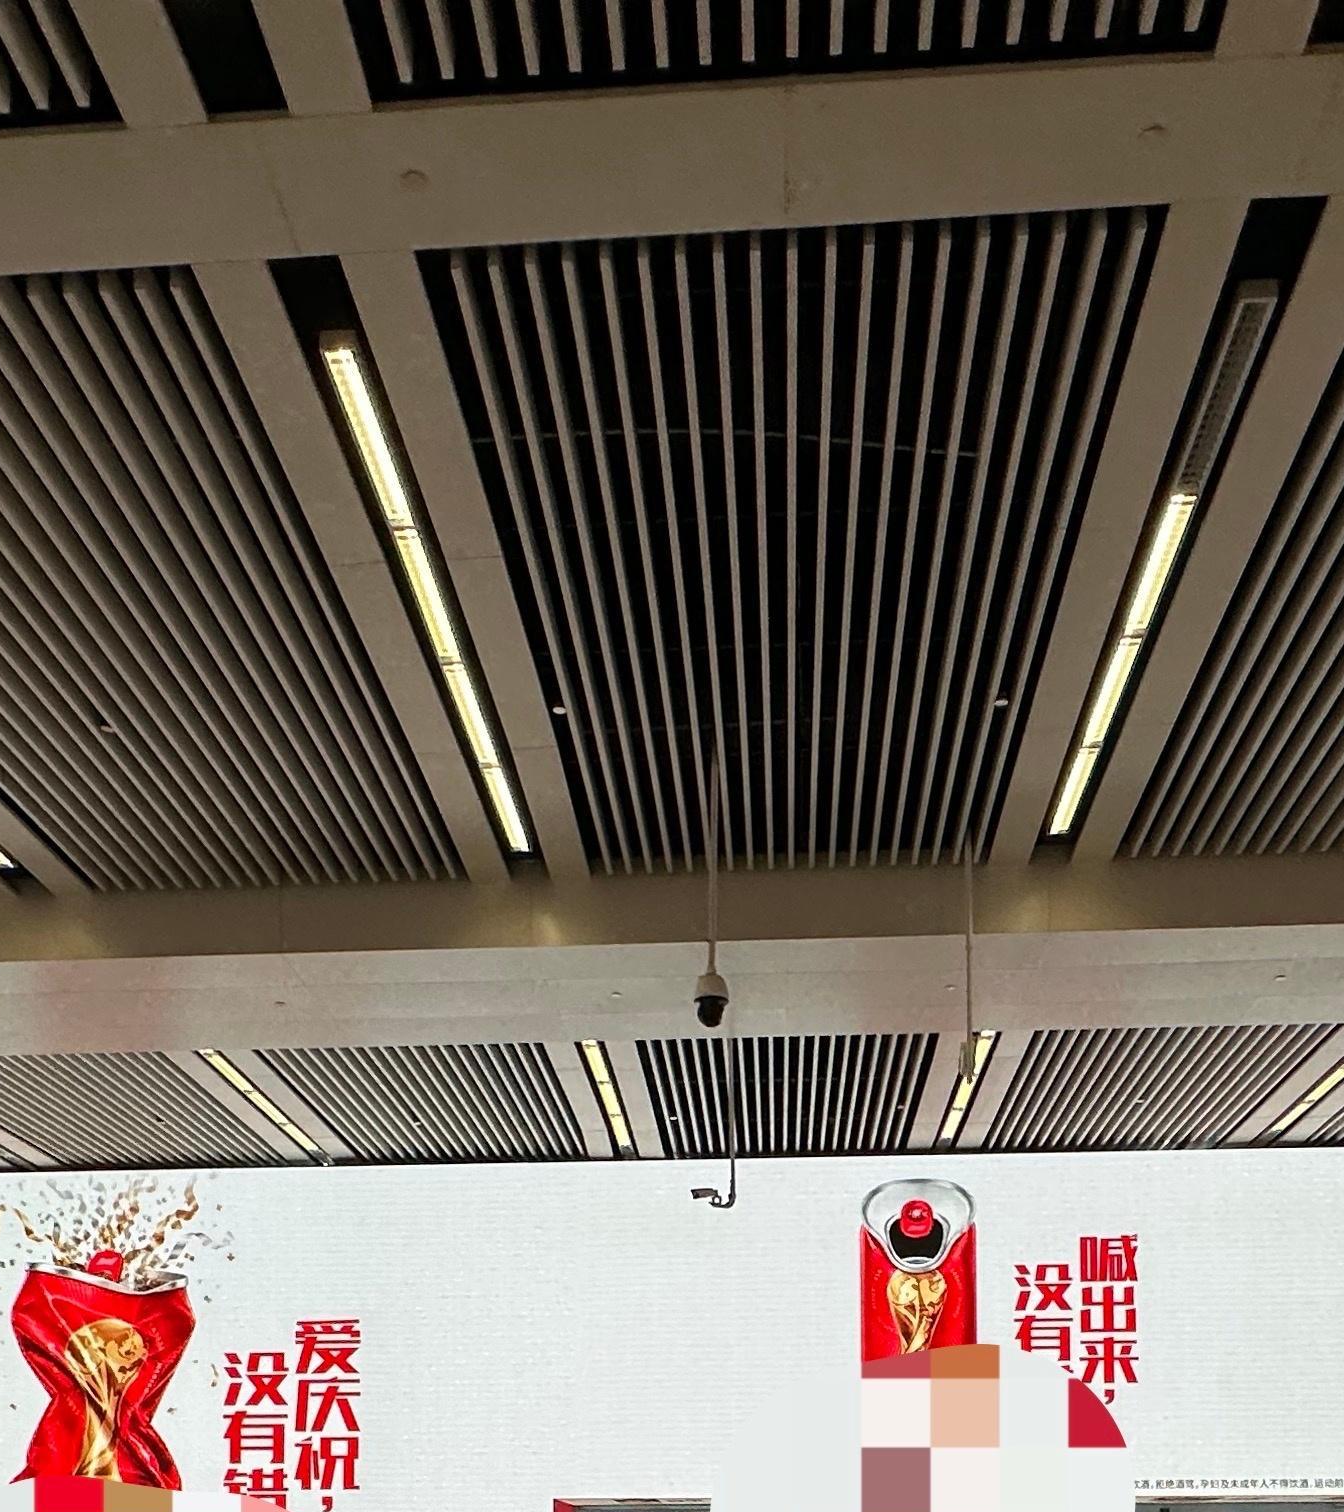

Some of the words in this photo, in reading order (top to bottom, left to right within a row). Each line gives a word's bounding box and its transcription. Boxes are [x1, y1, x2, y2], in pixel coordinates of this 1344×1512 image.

[1014, 1264, 1074, 1374] 没有
[1079, 1234, 1139, 1405] 喊出来，
